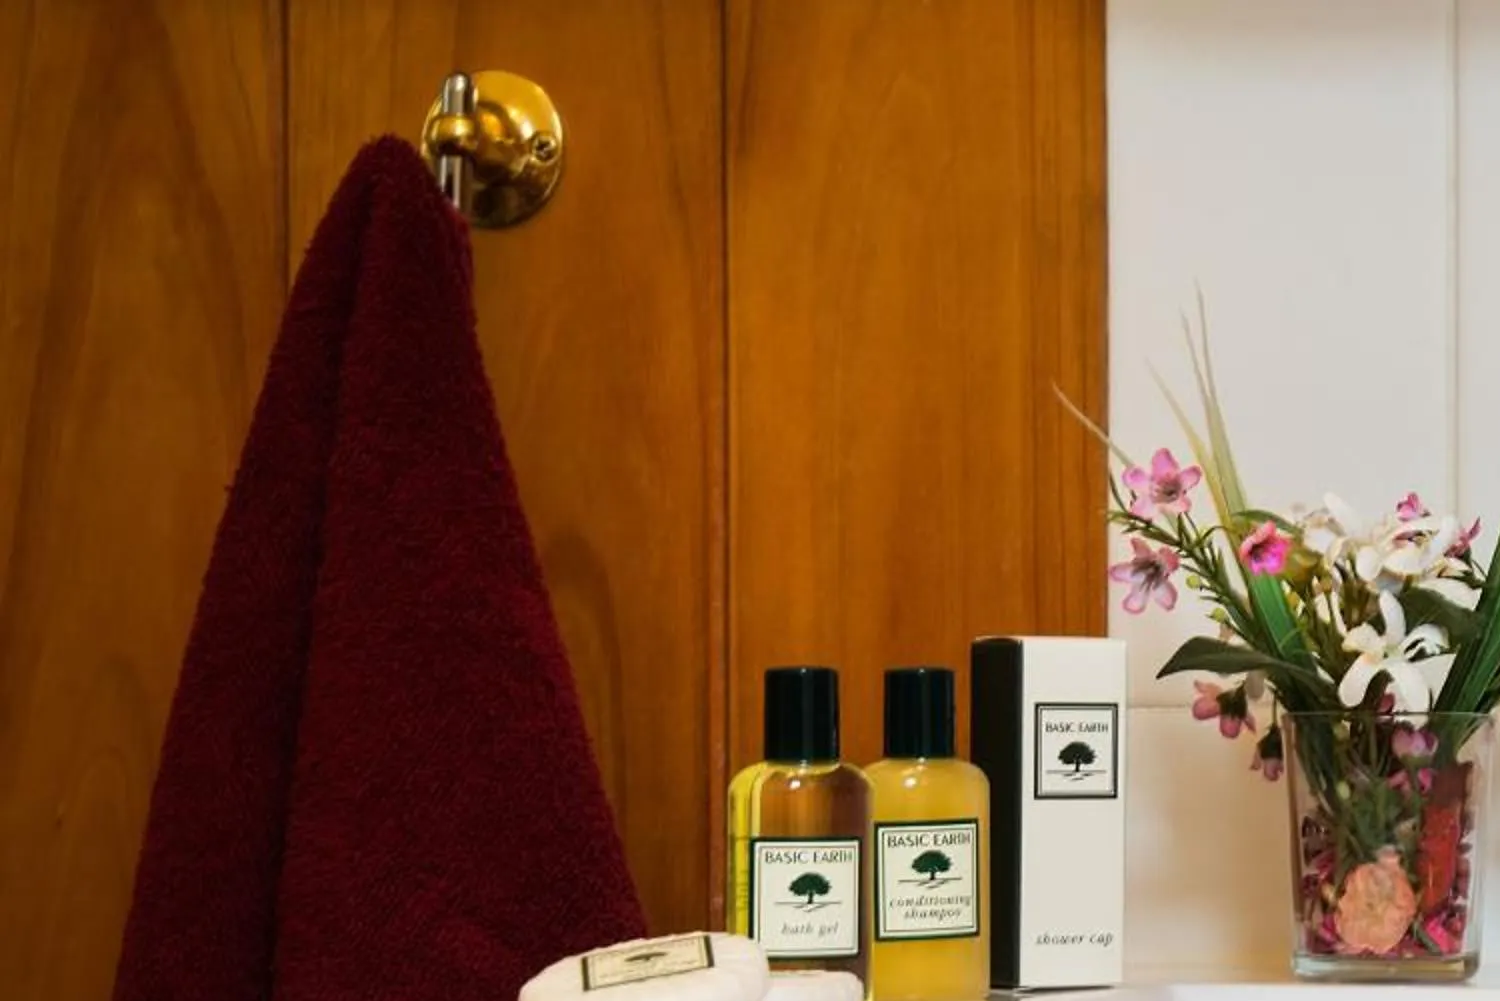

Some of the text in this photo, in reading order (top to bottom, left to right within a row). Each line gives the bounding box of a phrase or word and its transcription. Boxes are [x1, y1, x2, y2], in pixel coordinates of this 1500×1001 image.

[1045, 721, 1109, 733] BASIC EARTH
[887, 831, 971, 848] BASIC EARTH
[764, 850, 853, 864] BASIC EARTH
[889, 895, 971, 909] conditioning
[781, 921, 839, 937] bath gel
[1035, 931, 1114, 948] shower cap
